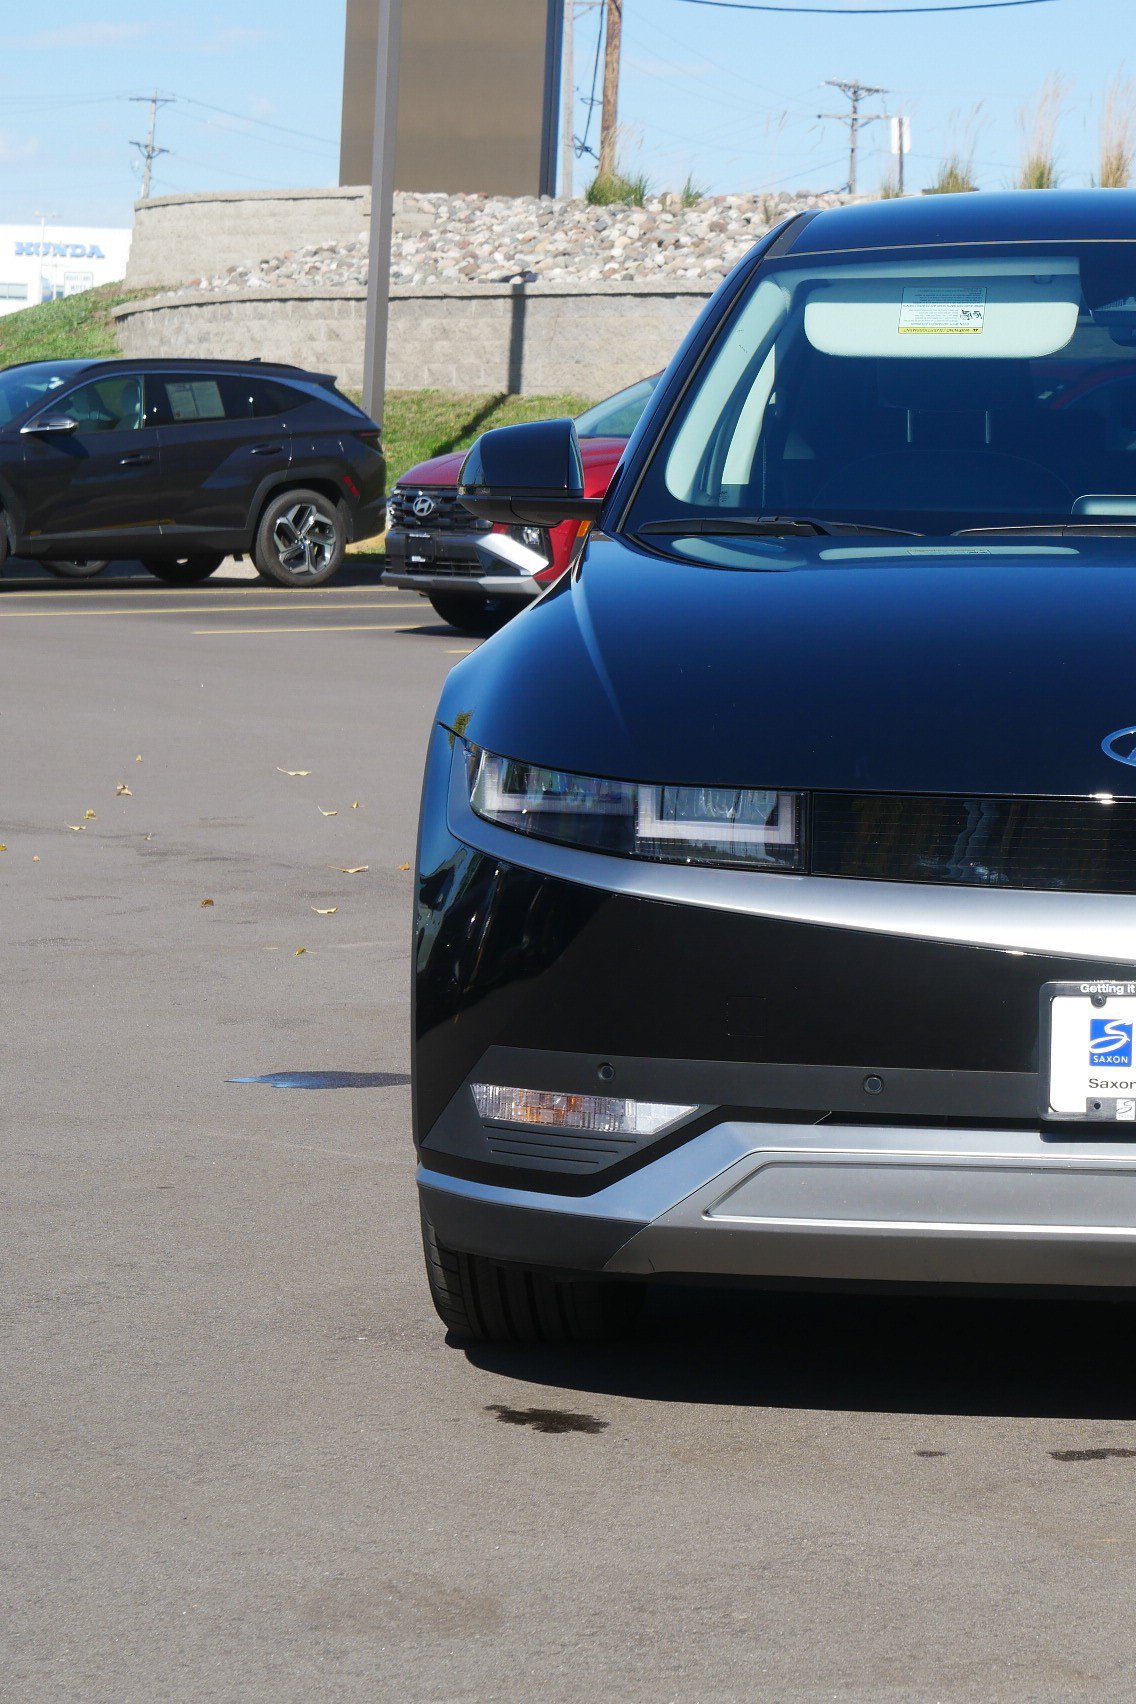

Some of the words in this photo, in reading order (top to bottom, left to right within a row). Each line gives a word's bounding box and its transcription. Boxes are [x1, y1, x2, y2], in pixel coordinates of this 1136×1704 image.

[15, 242, 105, 258] HONDA
[1080, 984, 1124, 995] Getting
[1127, 984, 1136, 993] it
[1093, 1055, 1128, 1064] SAXON
